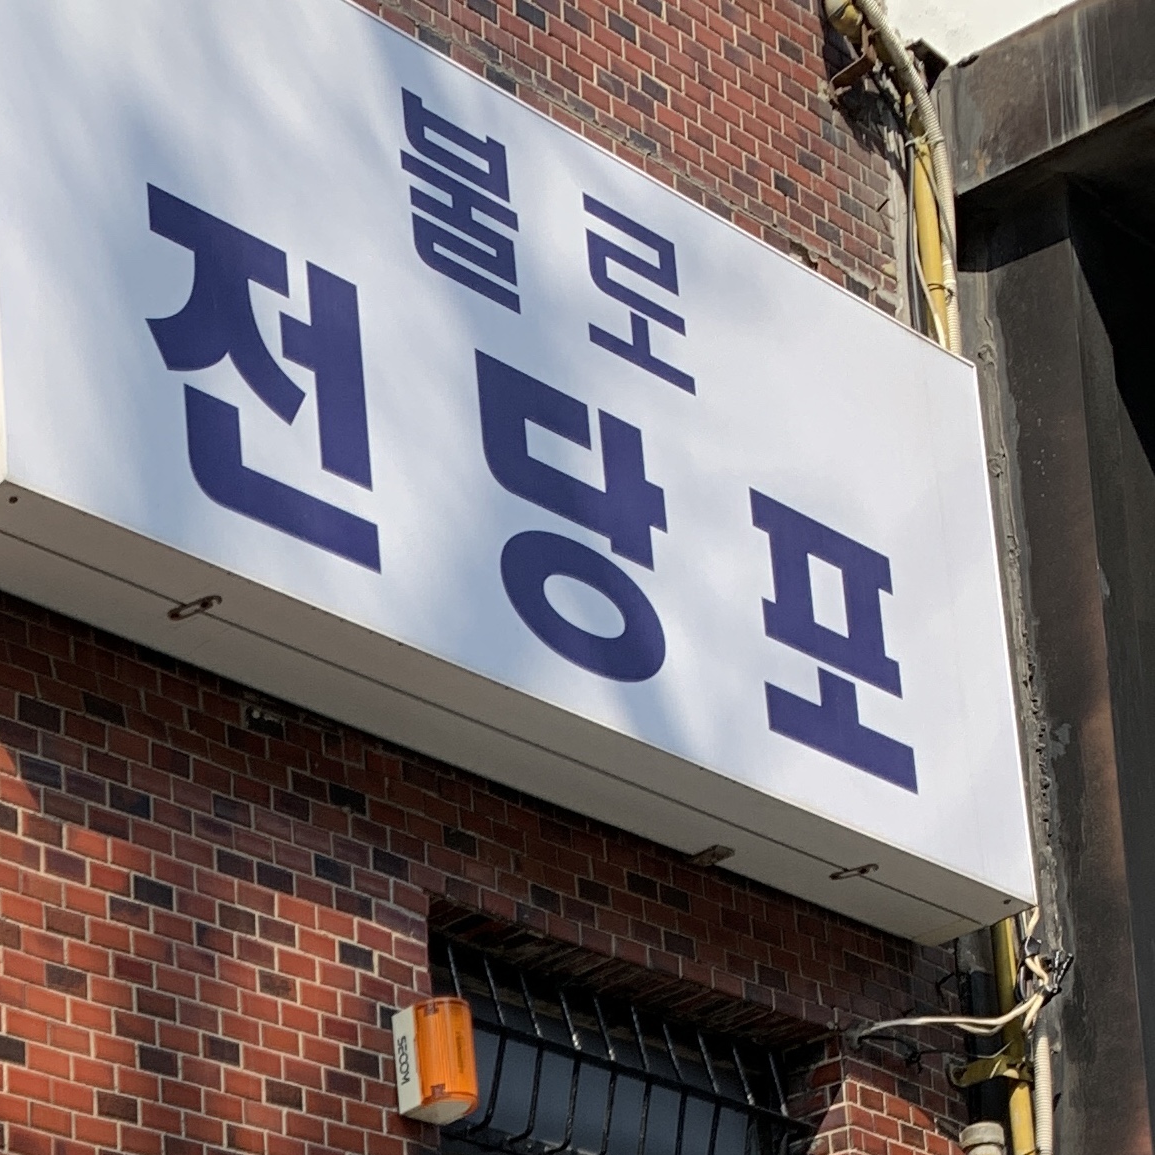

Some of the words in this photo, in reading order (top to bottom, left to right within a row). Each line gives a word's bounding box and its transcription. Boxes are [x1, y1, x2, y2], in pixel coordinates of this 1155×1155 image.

[399, 86, 697, 397] 불로
[145, 181, 919, 795] 전당포
[397, 1035, 410, 1086] SECOM
